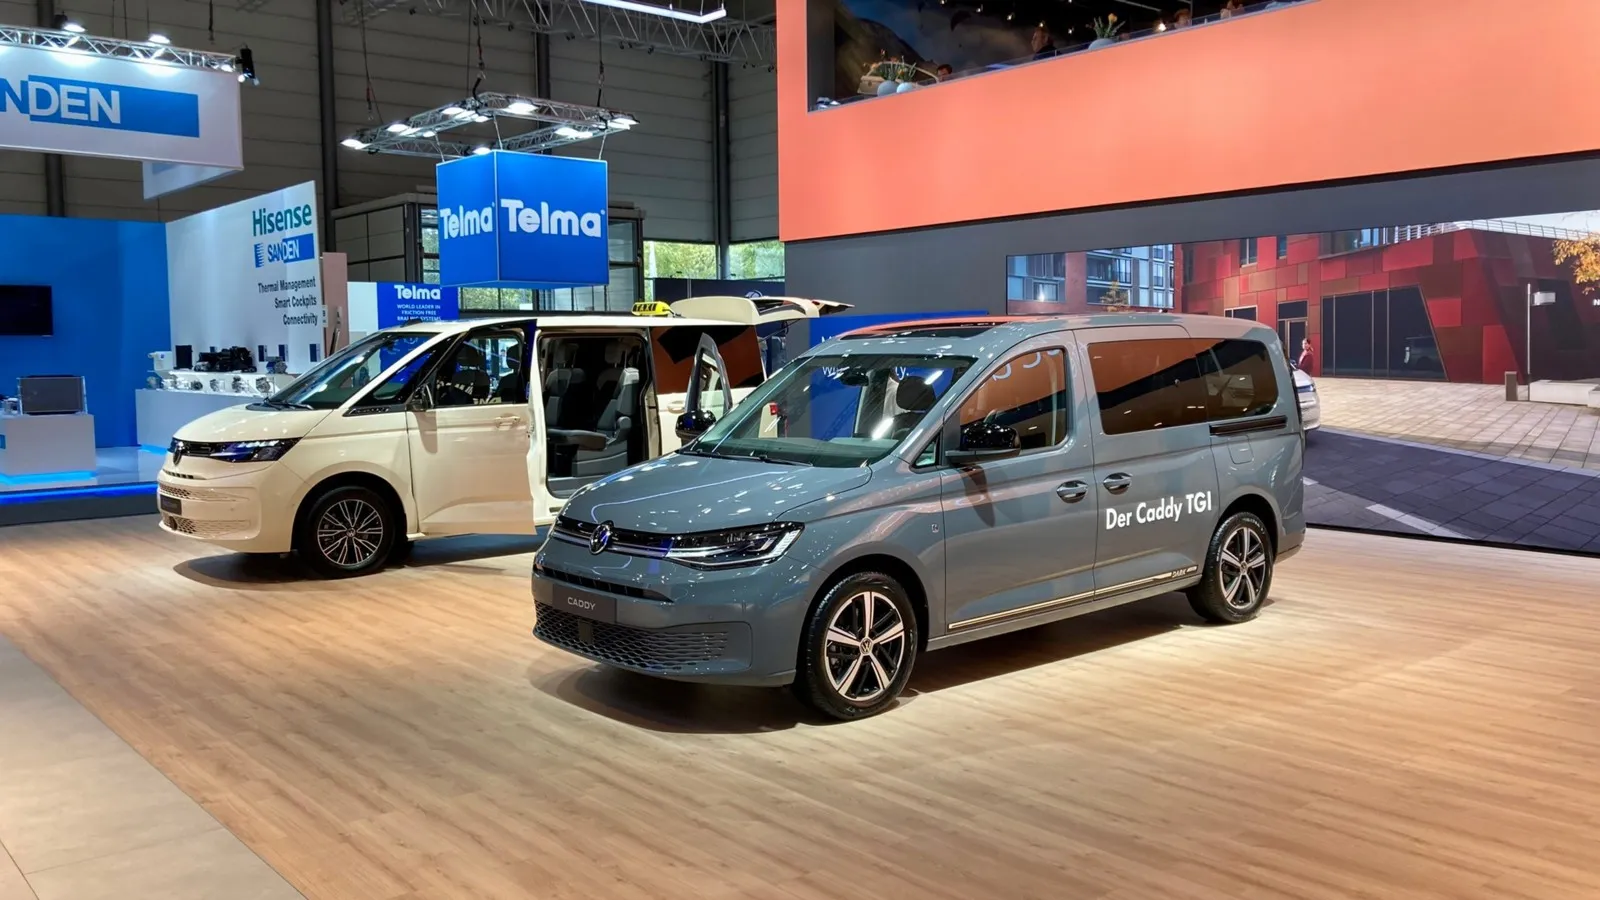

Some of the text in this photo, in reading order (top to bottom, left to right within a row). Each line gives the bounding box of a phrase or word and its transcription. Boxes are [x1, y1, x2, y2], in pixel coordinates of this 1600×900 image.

[252, 203, 312, 237] Hisense
[440, 205, 493, 240] Telma
[500, 198, 602, 238] Telma
[267, 239, 300, 263] SANDEN
[258, 275, 316, 294] Thermal Management
[394, 284, 441, 300] Telma
[274, 294, 317, 309] Smart Cockpits
[283, 313, 318, 327] Connectivity
[1106, 490, 1212, 530] Der Caddy TGI
[567, 596, 596, 611] CADDY
